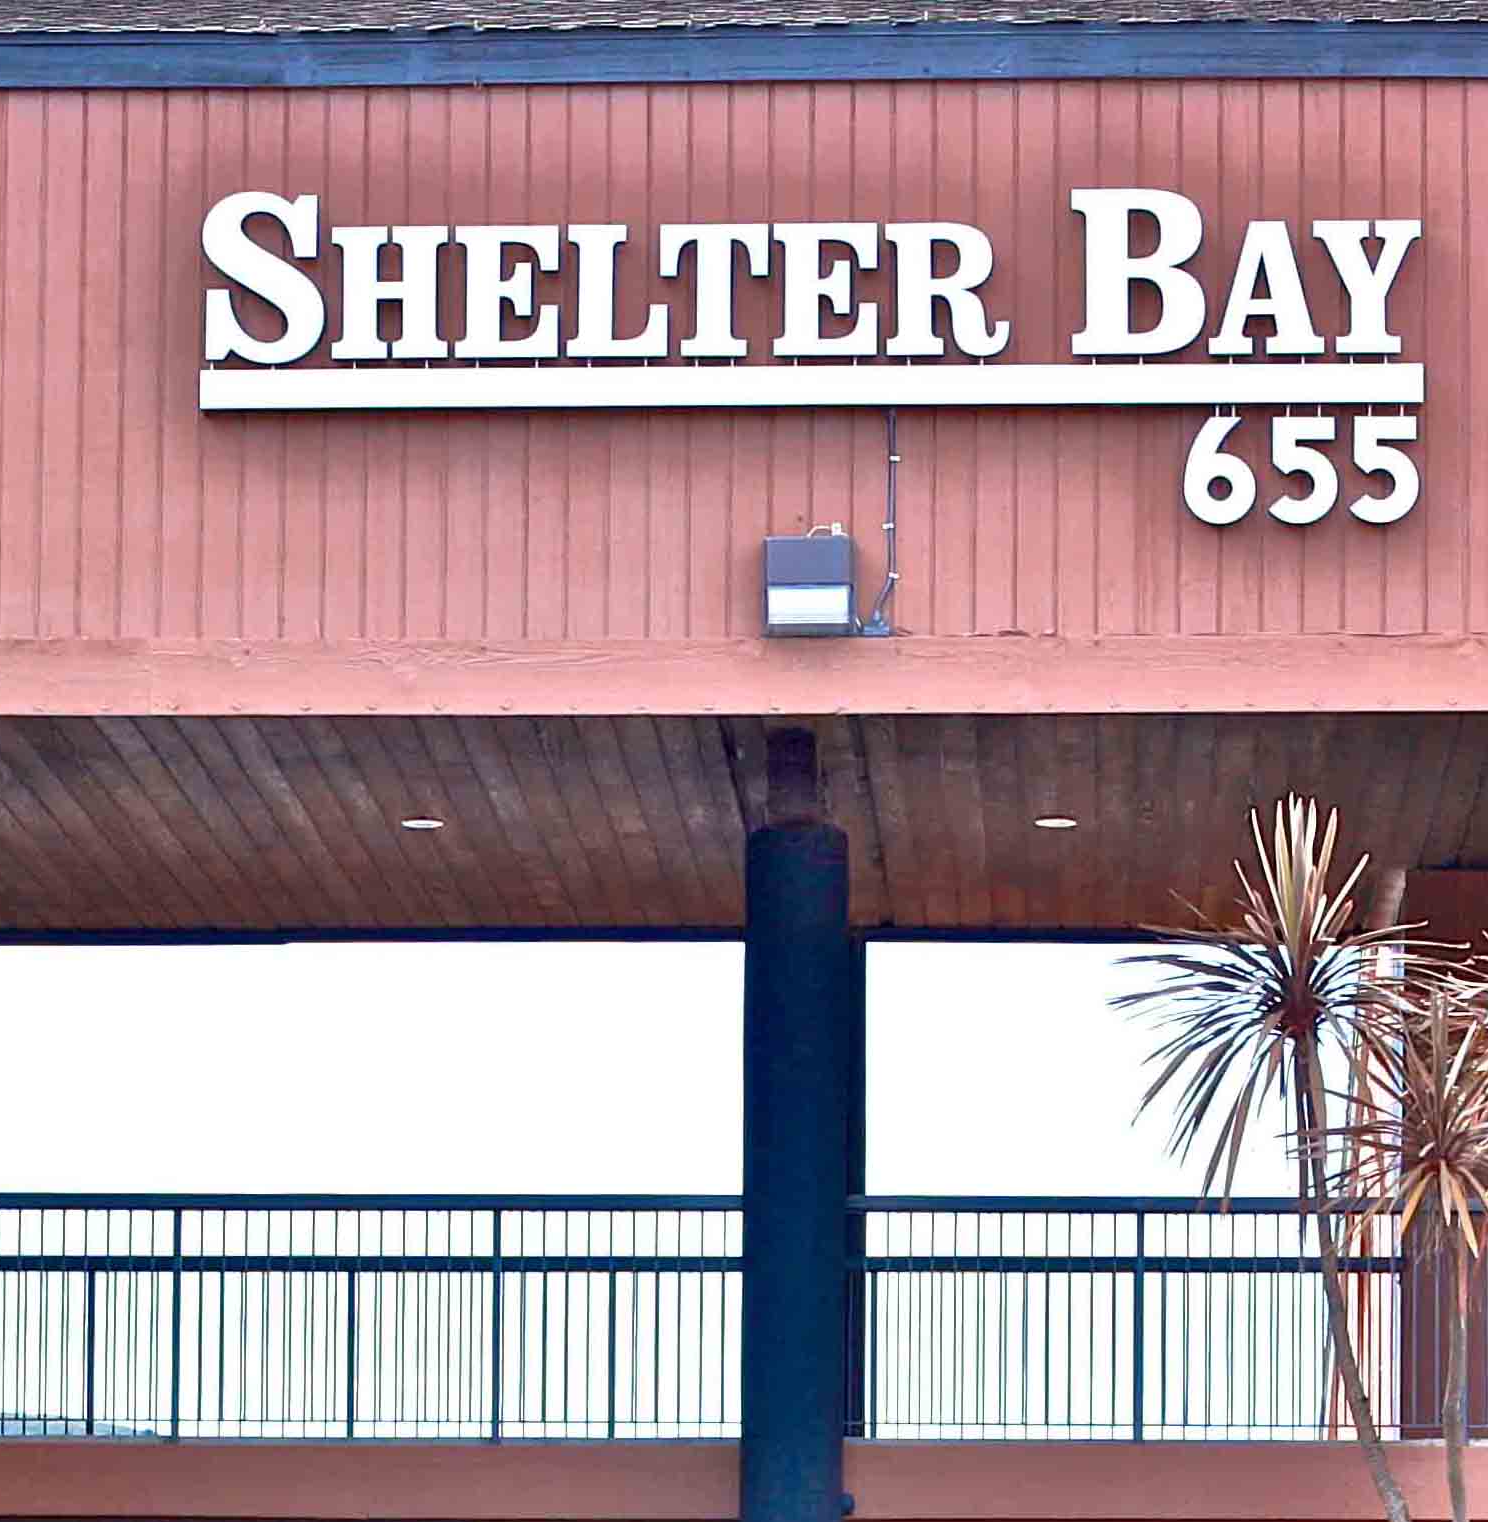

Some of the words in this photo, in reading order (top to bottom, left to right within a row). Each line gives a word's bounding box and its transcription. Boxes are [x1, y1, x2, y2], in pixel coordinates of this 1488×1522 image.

[201, 190, 1010, 365] SHELTER
[1070, 187, 1422, 356] BAY
[1183, 416, 1421, 525] 655
